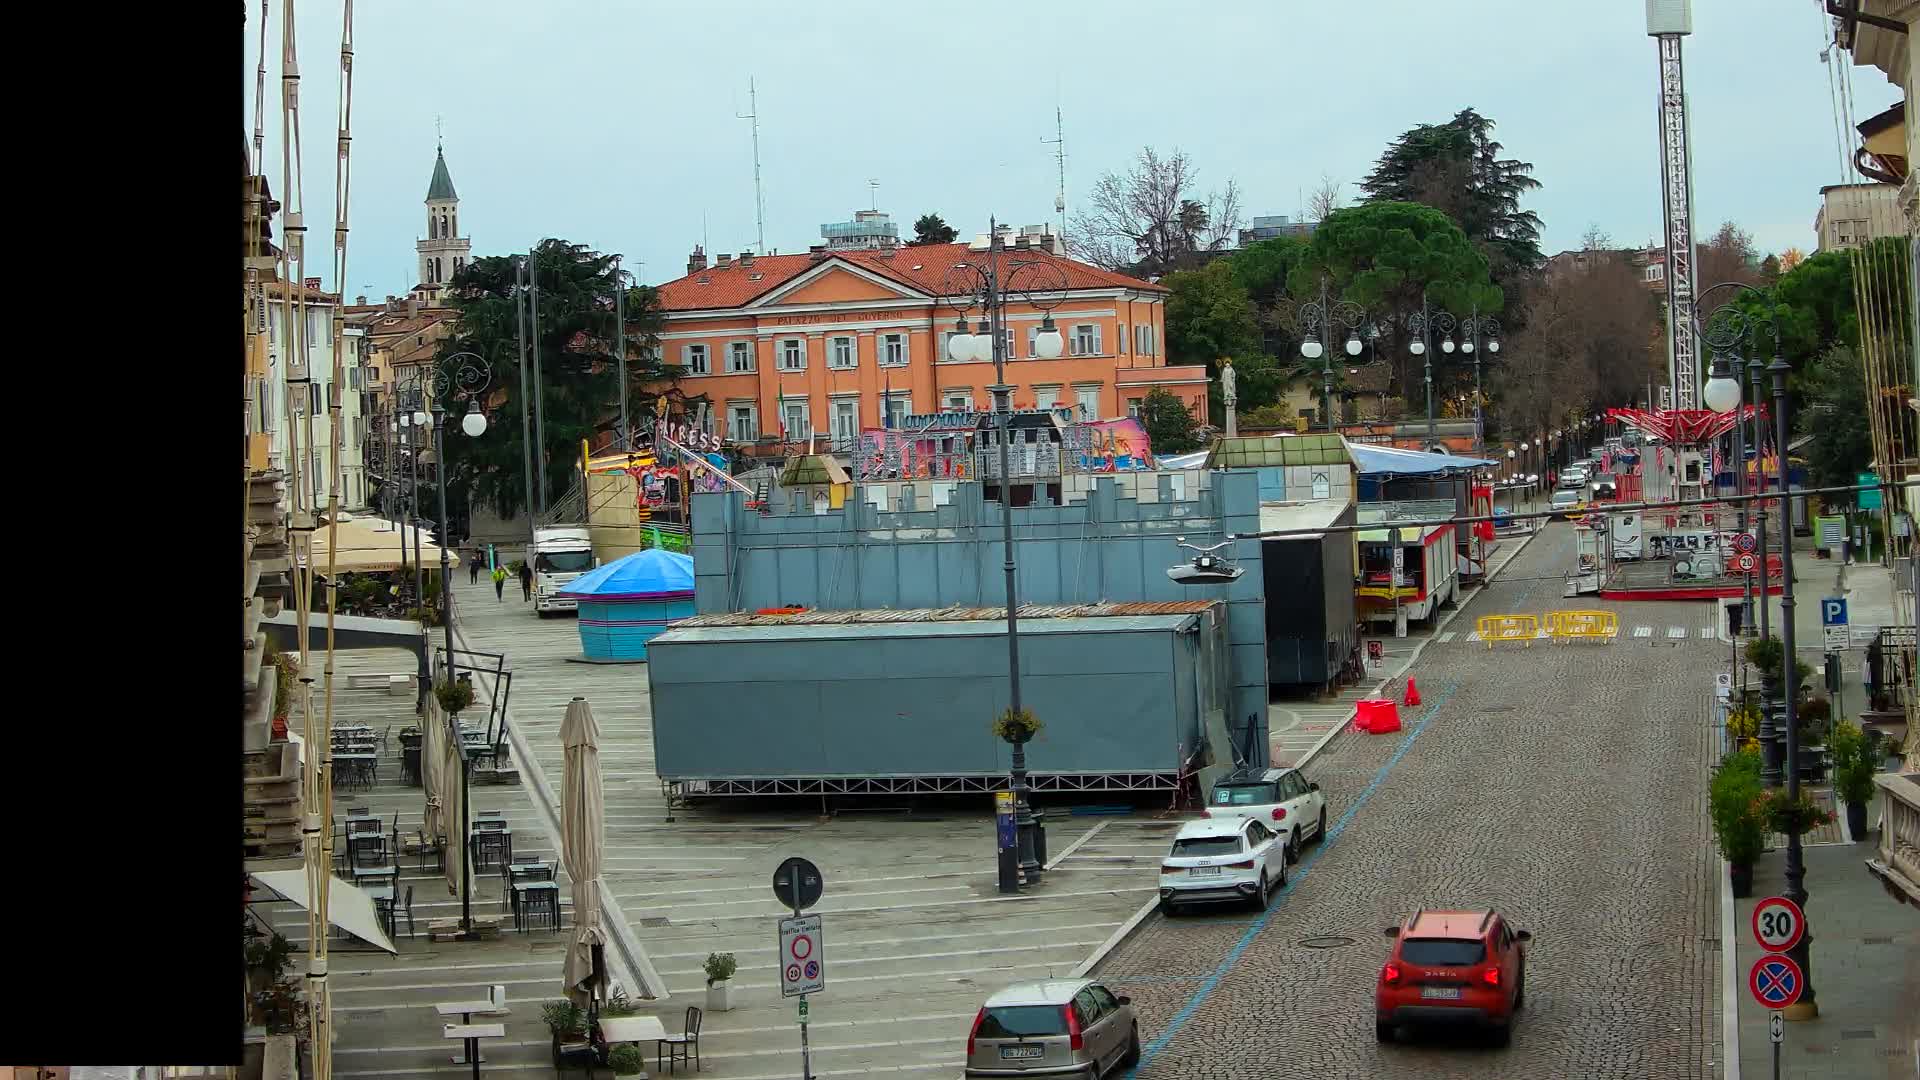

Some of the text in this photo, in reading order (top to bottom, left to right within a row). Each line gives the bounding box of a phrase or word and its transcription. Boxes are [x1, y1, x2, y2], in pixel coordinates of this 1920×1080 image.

[1741, 557, 1752, 567] 20
[1827, 602, 1841, 622] P
[1761, 912, 1791, 938] 30
